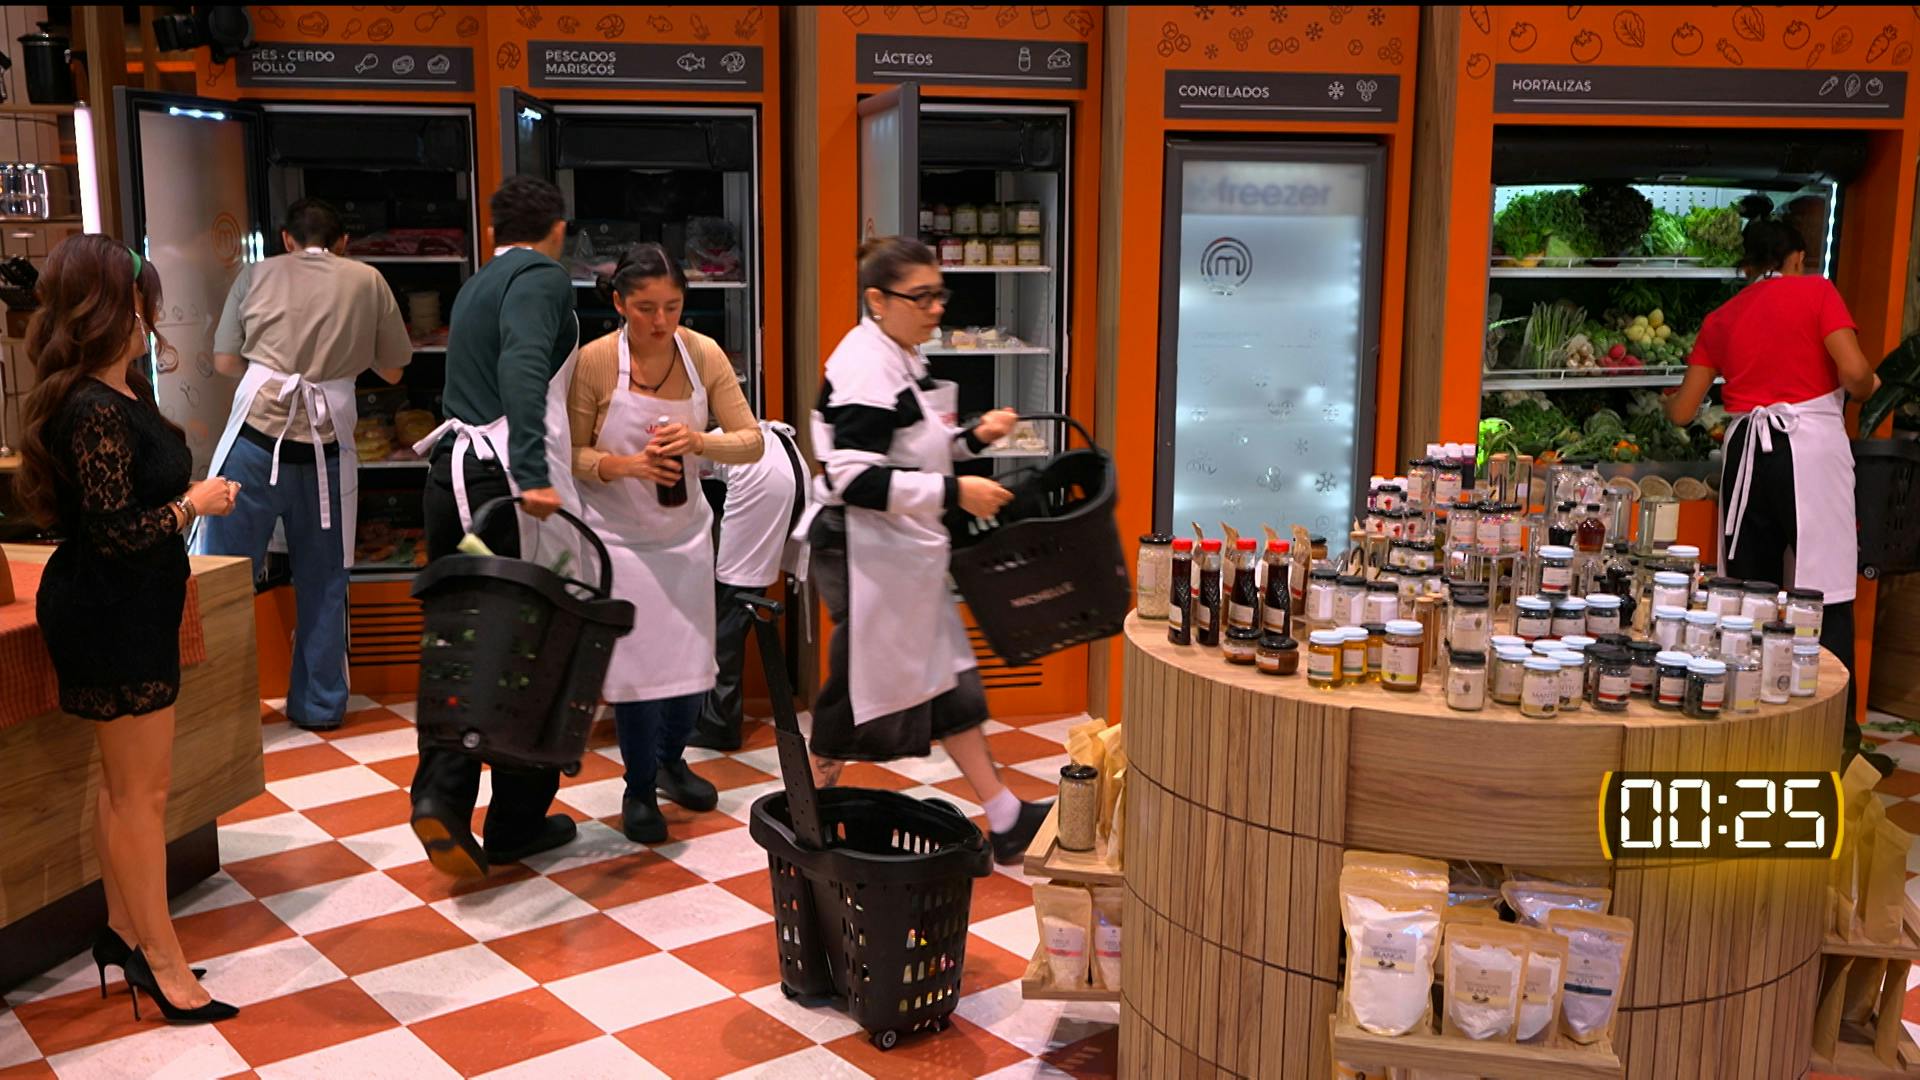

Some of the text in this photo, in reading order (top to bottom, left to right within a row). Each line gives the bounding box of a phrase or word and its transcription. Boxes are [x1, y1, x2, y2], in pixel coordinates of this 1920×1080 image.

[287, 49, 335, 62] CERDO
[545, 50, 617, 62] PESCADOS
[875, 50, 933, 66] LÁCTEOS
[252, 61, 296, 73] POLLO
[545, 63, 615, 75] MARISCOS
[1178, 84, 1270, 99] CONGELADOS
[1512, 79, 1592, 92] HORTALIZAS
